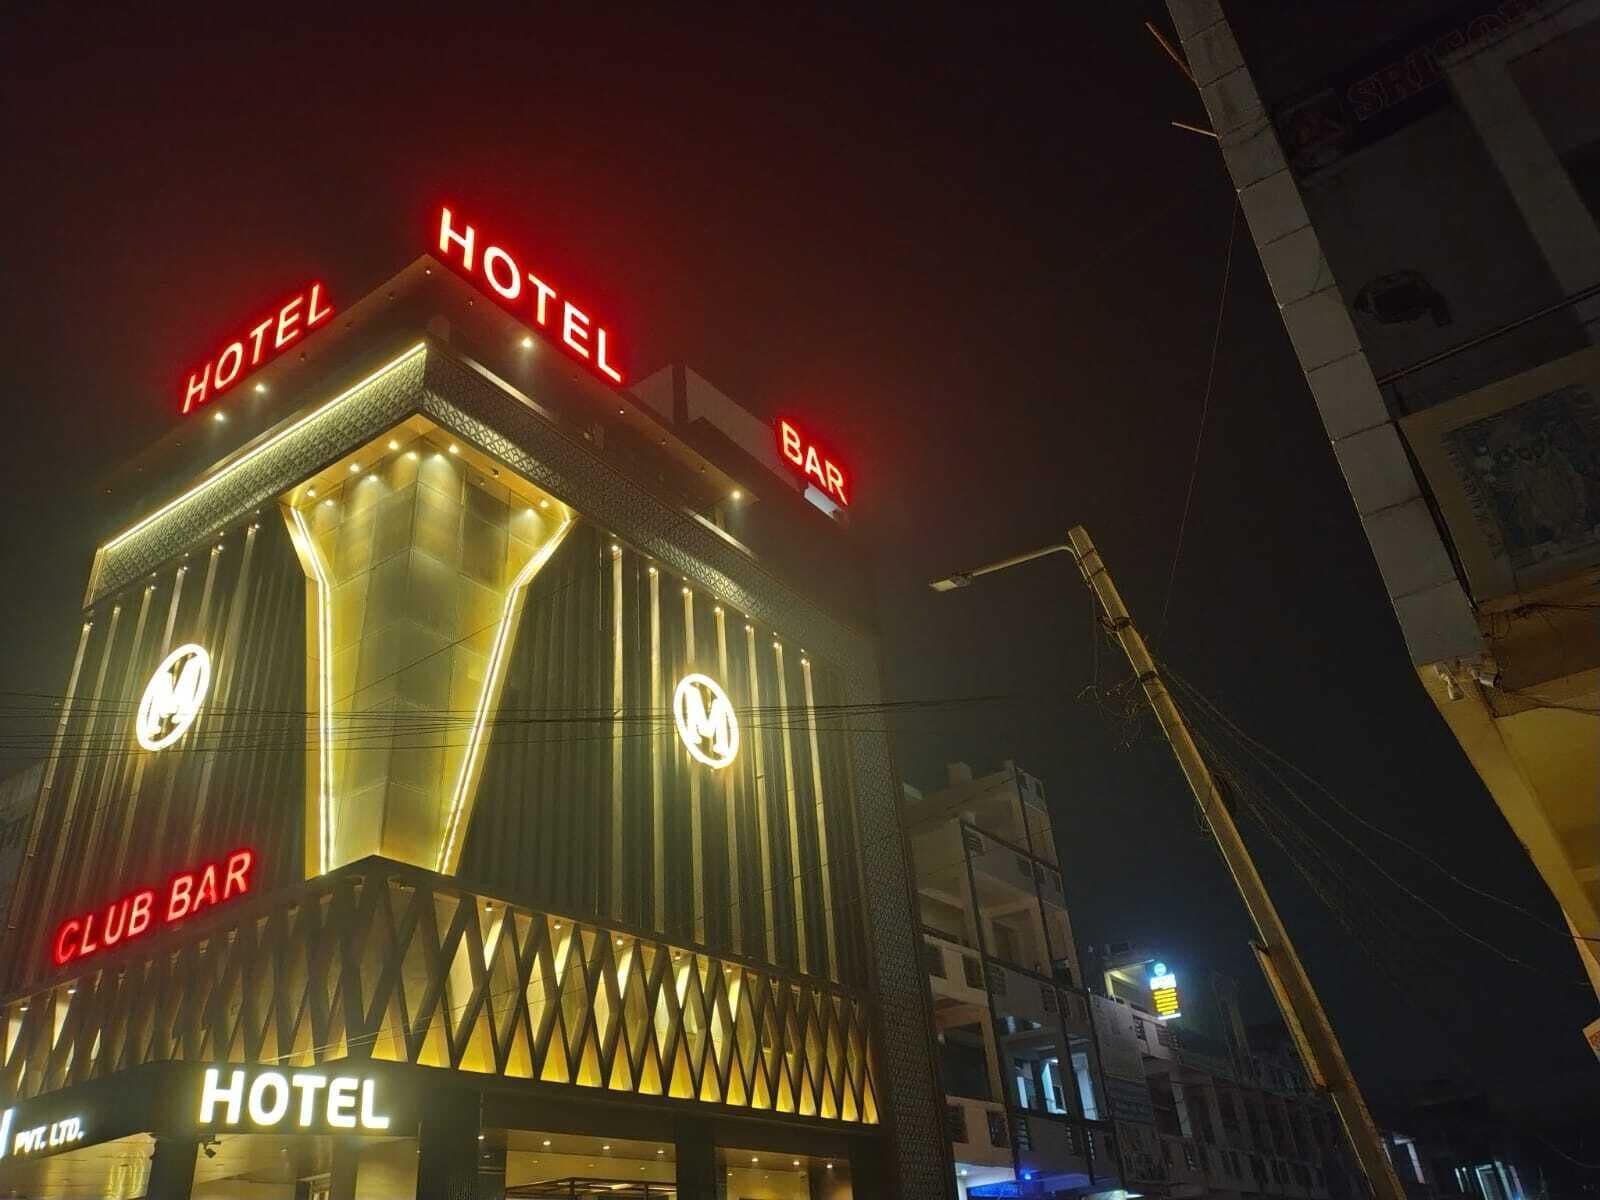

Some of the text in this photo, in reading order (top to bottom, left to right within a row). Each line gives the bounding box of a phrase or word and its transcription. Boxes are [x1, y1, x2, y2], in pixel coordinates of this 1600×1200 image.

[438, 206, 623, 383] HOTEL
[182, 283, 333, 414] HOTEL
[780, 420, 849, 506] BAR
[57, 852, 251, 964] CLUB BAR
[13, 1126, 47, 1156] PVT.
[48, 1116, 86, 1147] LTD.
[199, 1067, 391, 1129] HOTEL
